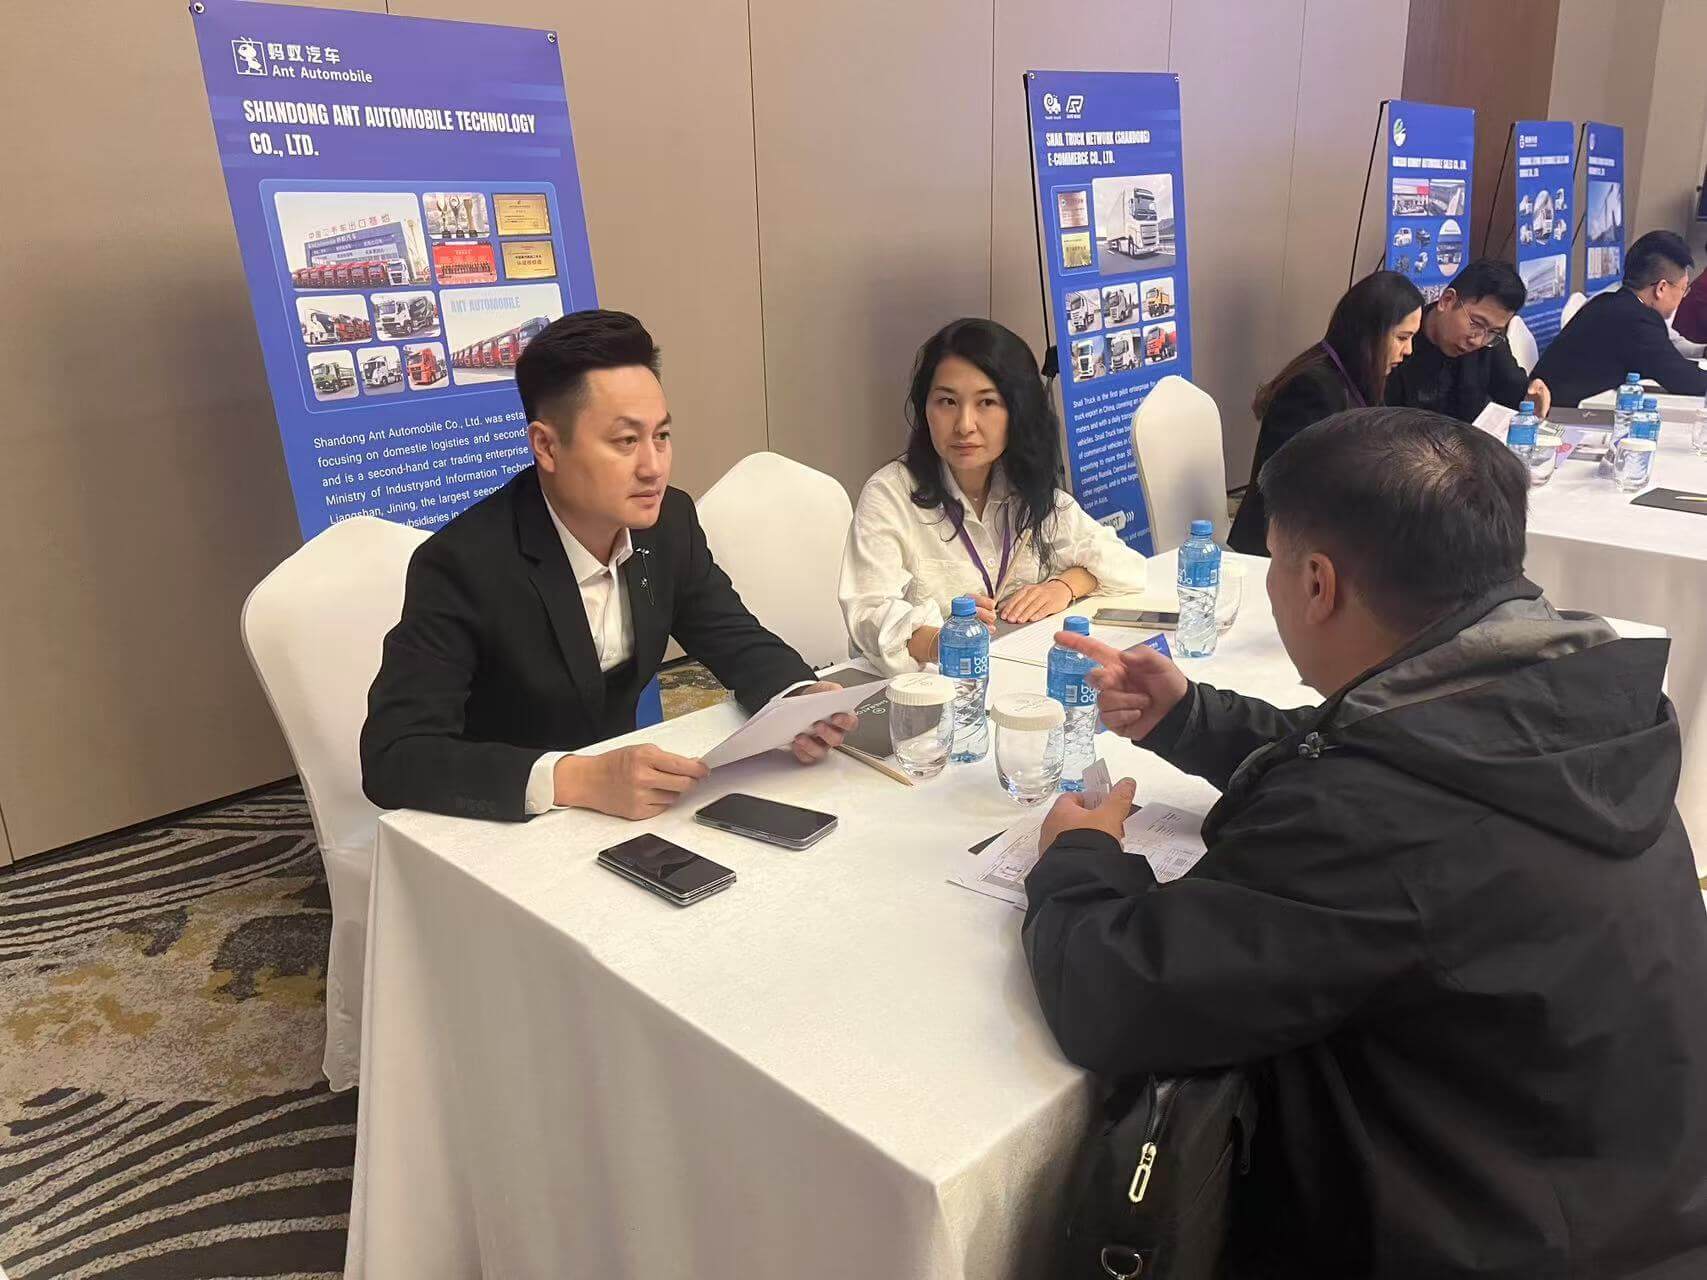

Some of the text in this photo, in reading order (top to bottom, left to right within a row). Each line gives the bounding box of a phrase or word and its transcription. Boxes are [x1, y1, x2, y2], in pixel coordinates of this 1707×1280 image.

[267, 43, 341, 64] 蚂蚁汽车
[272, 64, 373, 83] Ant Automobile
[243, 100, 536, 134] SHANDONG ANT AUTOMOBILE TECHNOLOGY
[249, 132, 320, 157] CO., LTD.
[1065, 132, 1085, 146] TRUCK
[1085, 131, 1114, 146] NETWORK
[1047, 150, 1115, 166] E-COMMERCE CO., LTD.
[313, 433, 366, 449] Shandong
[368, 430, 386, 441] Ant
[388, 421, 443, 438] Automobile
[464, 416, 483, 427] Ltd.
[485, 414, 503, 424] was
[505, 411, 527, 421] esta
[1090, 421, 1099, 430] and
[317, 453, 363, 468] focusing
[366, 451, 379, 460] on
[473, 432, 490, 444] and
[322, 446, 529, 487] and is a second-hand car trading enterprise
[325, 491, 366, 506] Ministry
[371, 486, 381, 498] of
[386, 476, 441, 495] Industryand
[446, 468, 498, 485] Information
[386, 501, 419, 514] Jining,
[421, 497, 436, 508] the
[439, 490, 471, 504] largest
[400, 512, 449, 528] ubsidiaries
